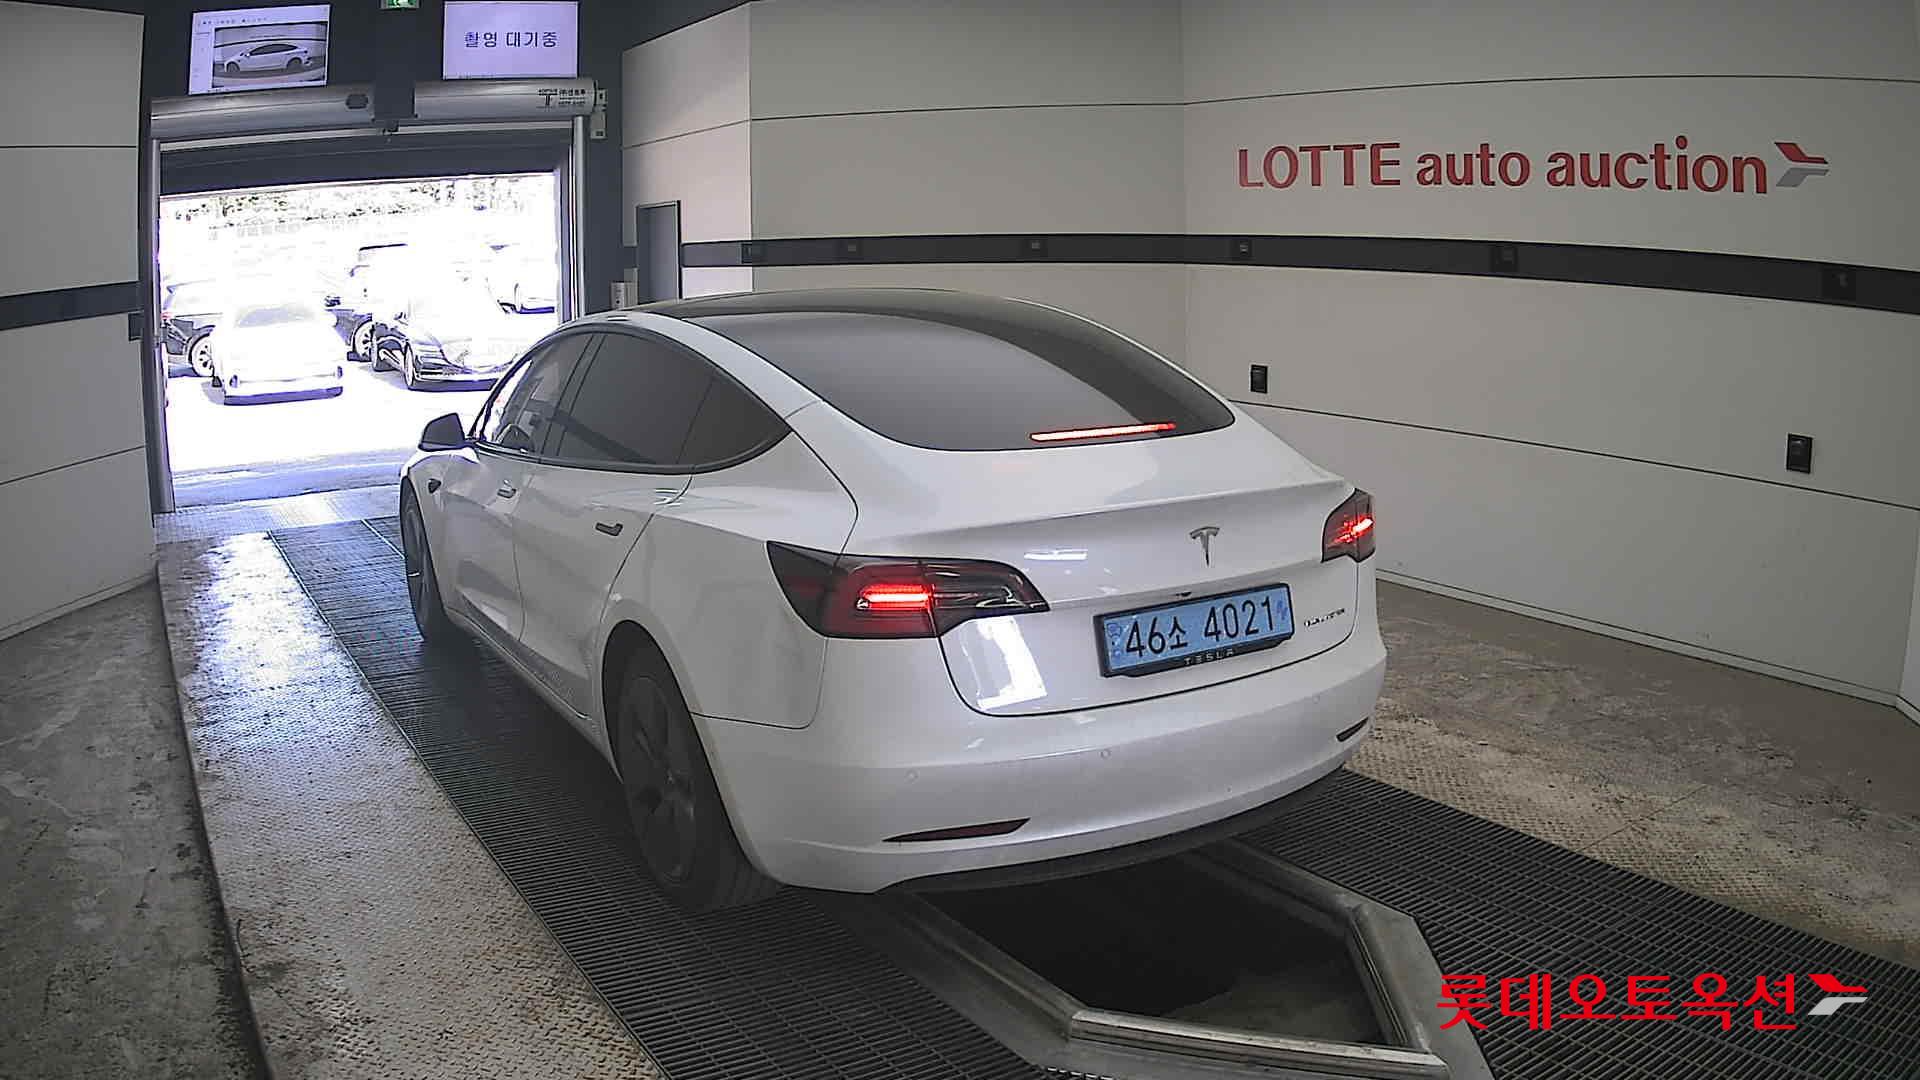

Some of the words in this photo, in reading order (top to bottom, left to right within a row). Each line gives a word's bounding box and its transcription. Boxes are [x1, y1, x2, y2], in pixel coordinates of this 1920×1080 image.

[464, 31, 498, 48] 촬영
[505, 31, 558, 48] 대기중
[1238, 142, 1401, 188] LOTTE
[1416, 142, 1530, 188] auto
[1546, 135, 1767, 194] auction
[1126, 616, 1188, 658] 46소
[1204, 595, 1275, 642] 4021
[1184, 649, 1235, 666] TESLA
